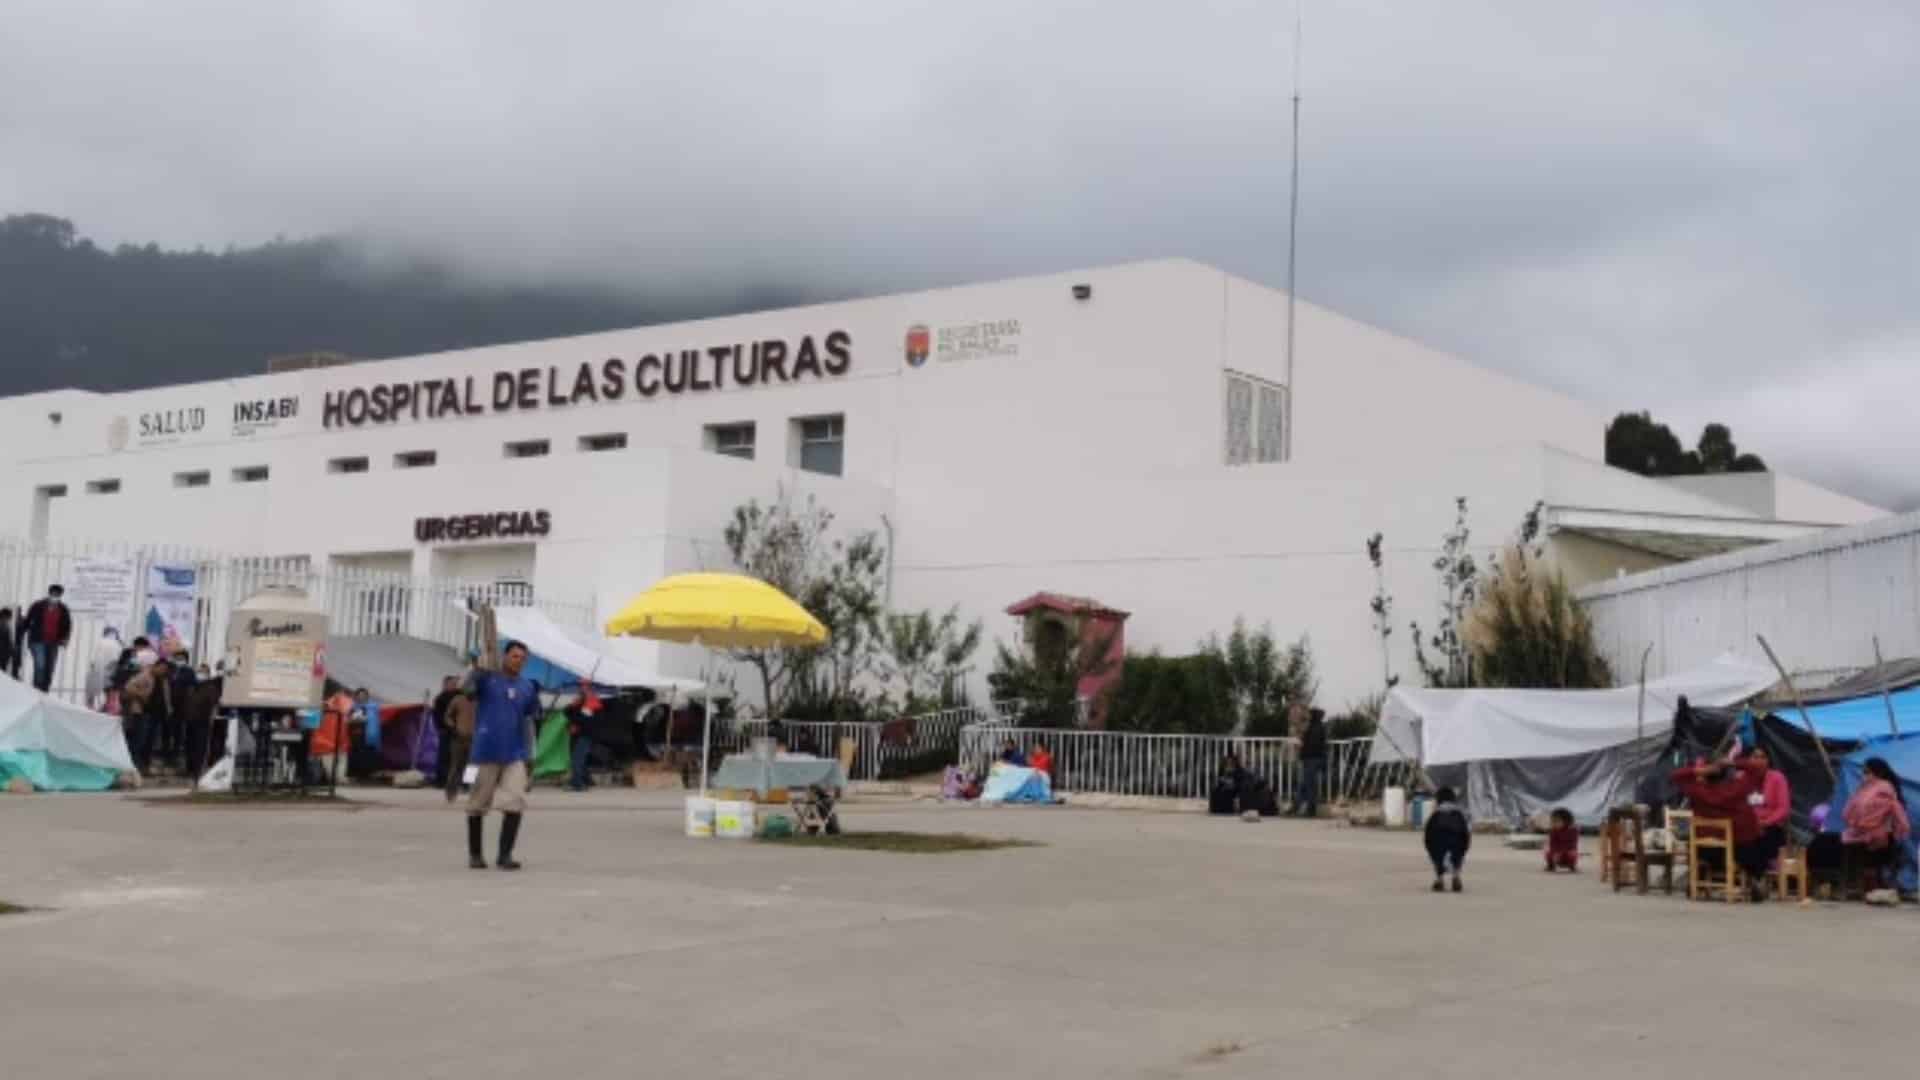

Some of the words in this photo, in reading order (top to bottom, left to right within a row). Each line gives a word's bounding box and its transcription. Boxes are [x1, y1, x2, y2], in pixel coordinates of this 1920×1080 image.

[323, 377, 483, 428] HOSPITAL
[493, 368, 540, 410] DE
[547, 359, 625, 405] LAS
[635, 331, 851, 395] CULTURAS
[138, 407, 206, 437] SALUD
[232, 396, 299, 424] INSABI
[414, 510, 550, 541] URGENCIAS
